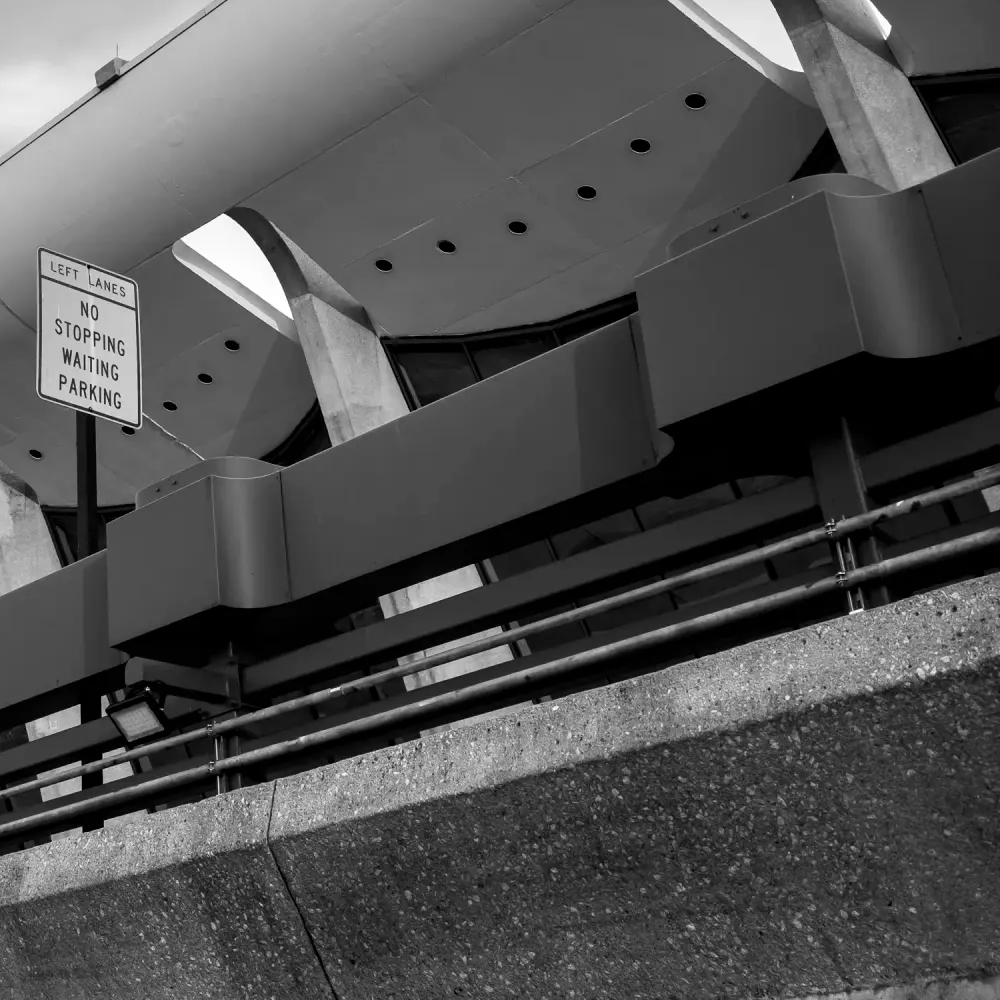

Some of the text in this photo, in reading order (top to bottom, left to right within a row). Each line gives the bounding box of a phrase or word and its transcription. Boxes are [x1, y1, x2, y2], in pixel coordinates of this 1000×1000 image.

[50, 261, 126, 298] LEFT LANES
[80, 300, 99, 321] NO
[54, 318, 125, 357] STOPPING
[62, 347, 119, 381] WAITING
[59, 374, 122, 409] PARKING
